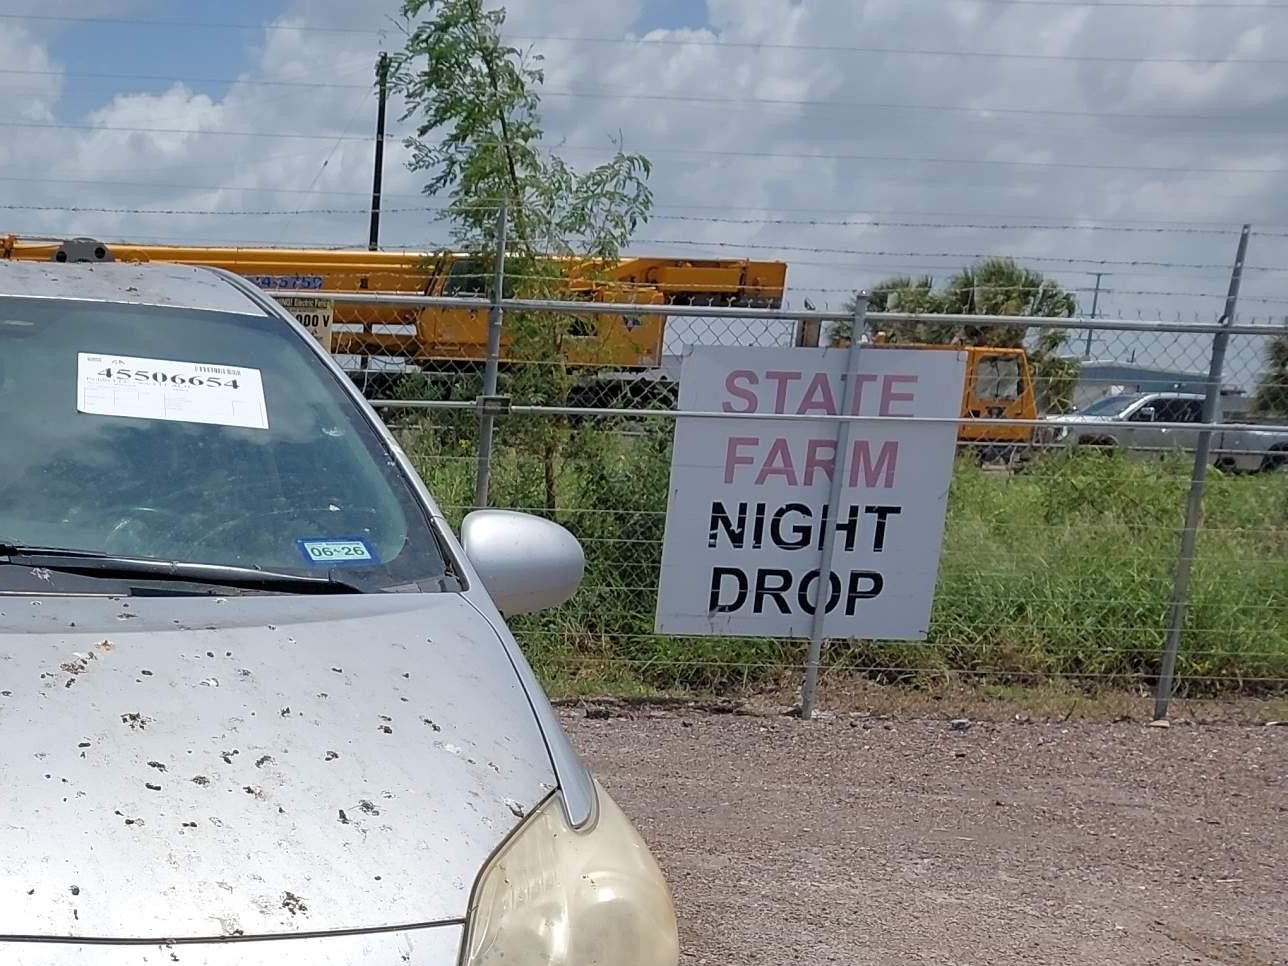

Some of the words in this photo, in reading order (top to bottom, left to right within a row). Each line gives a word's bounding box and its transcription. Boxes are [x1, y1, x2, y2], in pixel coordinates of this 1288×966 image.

[323, 315, 330, 327] V
[96, 367, 240, 390] 45506654
[721, 369, 918, 418] STATE
[723, 436, 899, 489] FARM
[707, 500, 902, 553] NIGHT
[708, 565, 884, 616] DROP
